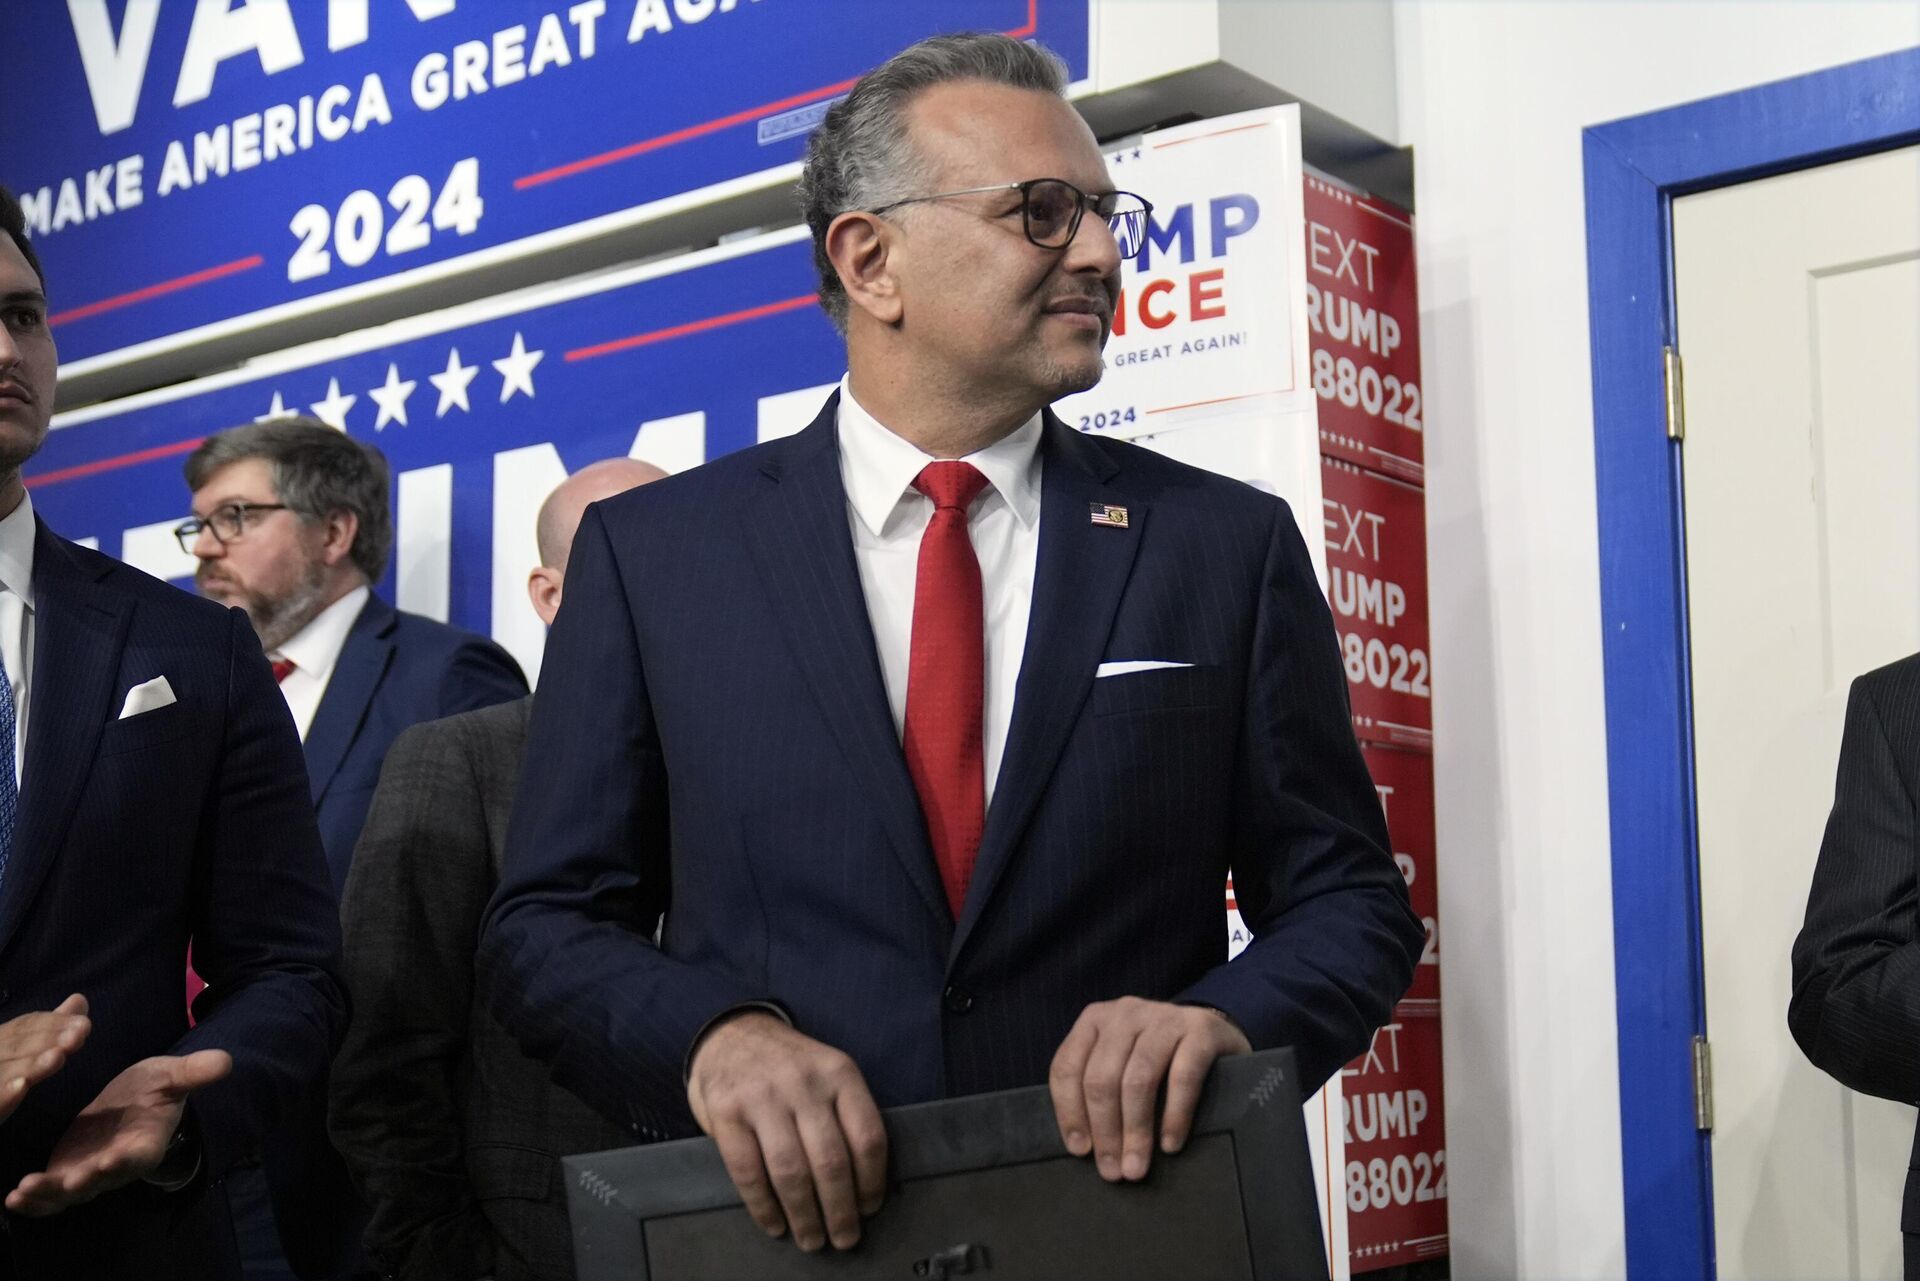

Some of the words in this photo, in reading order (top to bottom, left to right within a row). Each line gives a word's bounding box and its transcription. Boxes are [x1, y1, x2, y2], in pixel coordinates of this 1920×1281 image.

[20, 154, 144, 237] MAKE
[157, 73, 392, 196] AMERICA
[411, 0, 606, 111] GREAT
[288, 157, 484, 281] 2024
[1306, 221, 1380, 293] EXT
[1115, 345, 1173, 367] GREAT
[1181, 331, 1248, 355] AGAIN!
[1079, 406, 1137, 431] 2024
[1313, 348, 1423, 432] 88022
[1327, 566, 1407, 628] UMP
[1337, 632, 1430, 698] 8022
[1346, 1151, 1448, 1213] 88022
